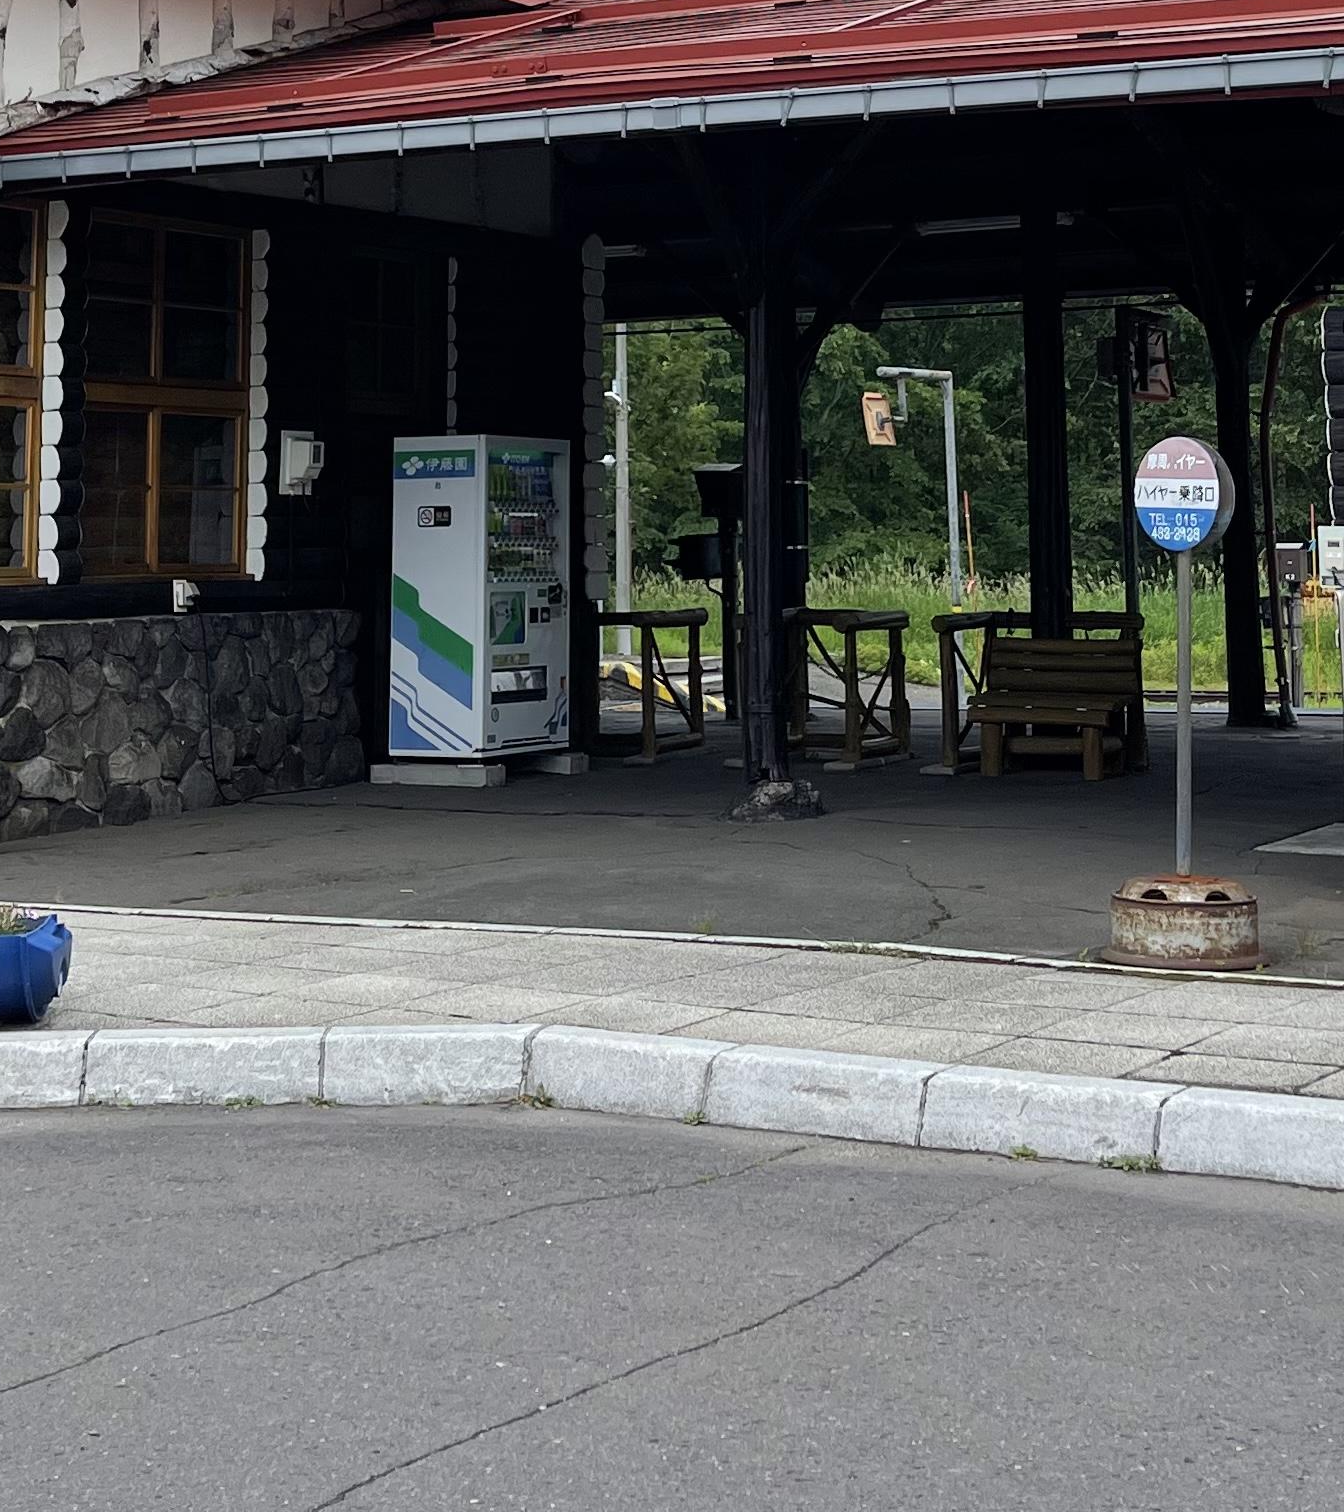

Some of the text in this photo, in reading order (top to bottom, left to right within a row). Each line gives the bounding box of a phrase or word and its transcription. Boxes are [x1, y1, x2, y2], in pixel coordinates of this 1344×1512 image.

[425, 456, 468, 473] 伊藤園
[1137, 485, 1215, 503] ハイヤー乗降口
